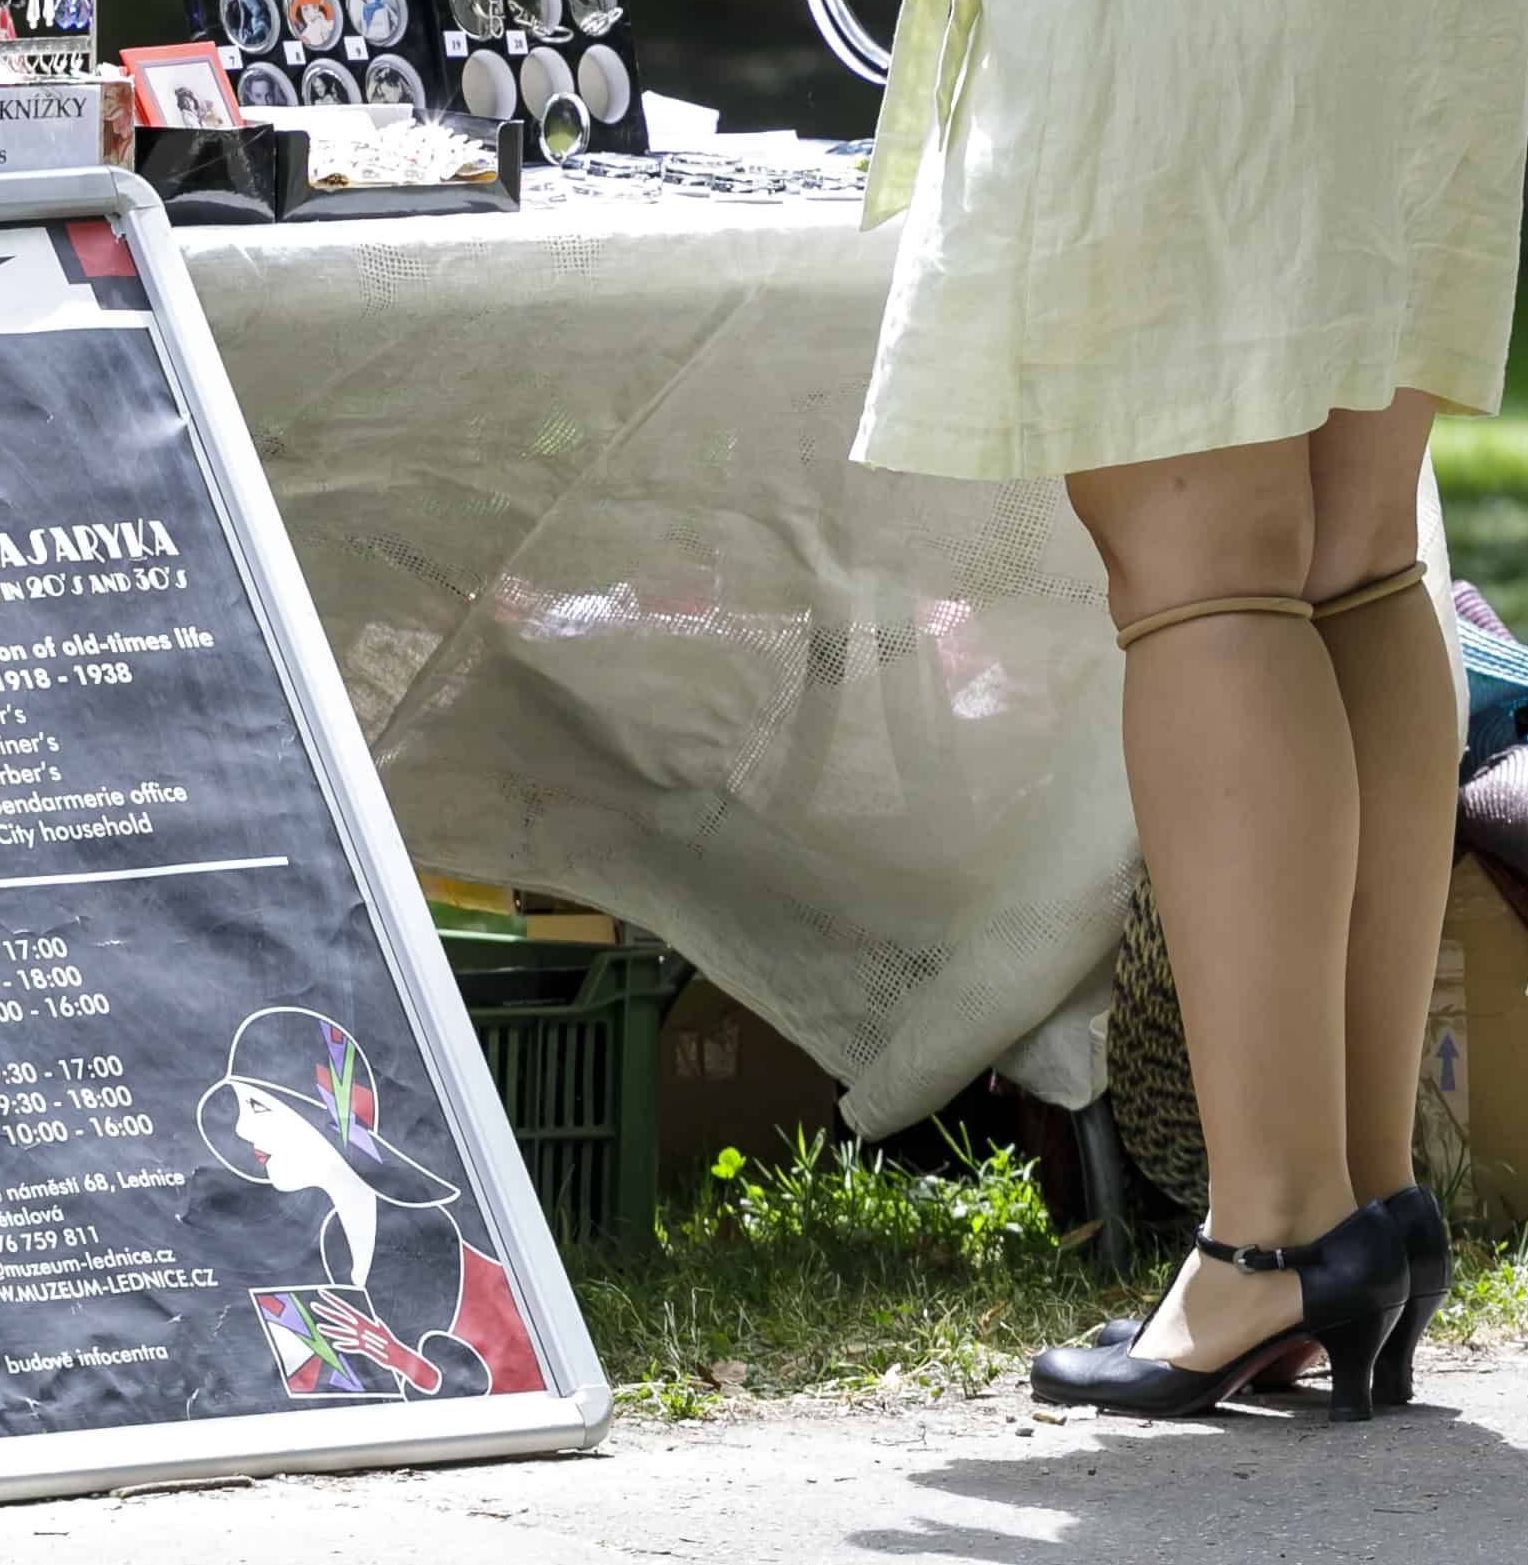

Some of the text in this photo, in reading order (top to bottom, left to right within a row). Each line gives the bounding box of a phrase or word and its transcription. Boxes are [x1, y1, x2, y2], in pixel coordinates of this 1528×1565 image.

[0, 92, 87, 120] KNÍŽKY
[0, 581, 25, 603] IN
[89, 572, 131, 594] AND
[33, 636, 56, 660] of
[62, 632, 172, 658] old-times
[173, 626, 214, 649] life
[74, 662, 133, 686] 1938
[130, 782, 188, 804] office
[39, 812, 154, 843] household
[3, 937, 68, 961] 17:00
[17, 966, 82, 990] 18:00
[45, 994, 110, 1018] 16:00
[59, 1055, 124, 1080] 17:00
[67, 1086, 133, 1109] 18:00
[3, 1121, 68, 1145] 10:00
[89, 1115, 154, 1138] 16:00
[84, 1174, 116, 1193] 68,
[116, 1170, 186, 1190] Lednice
[21, 1230, 57, 1251] 759
[65, 1225, 100, 1247] 811
[5, 1350, 73, 1374] budově
[75, 1344, 169, 1367] infocentra
